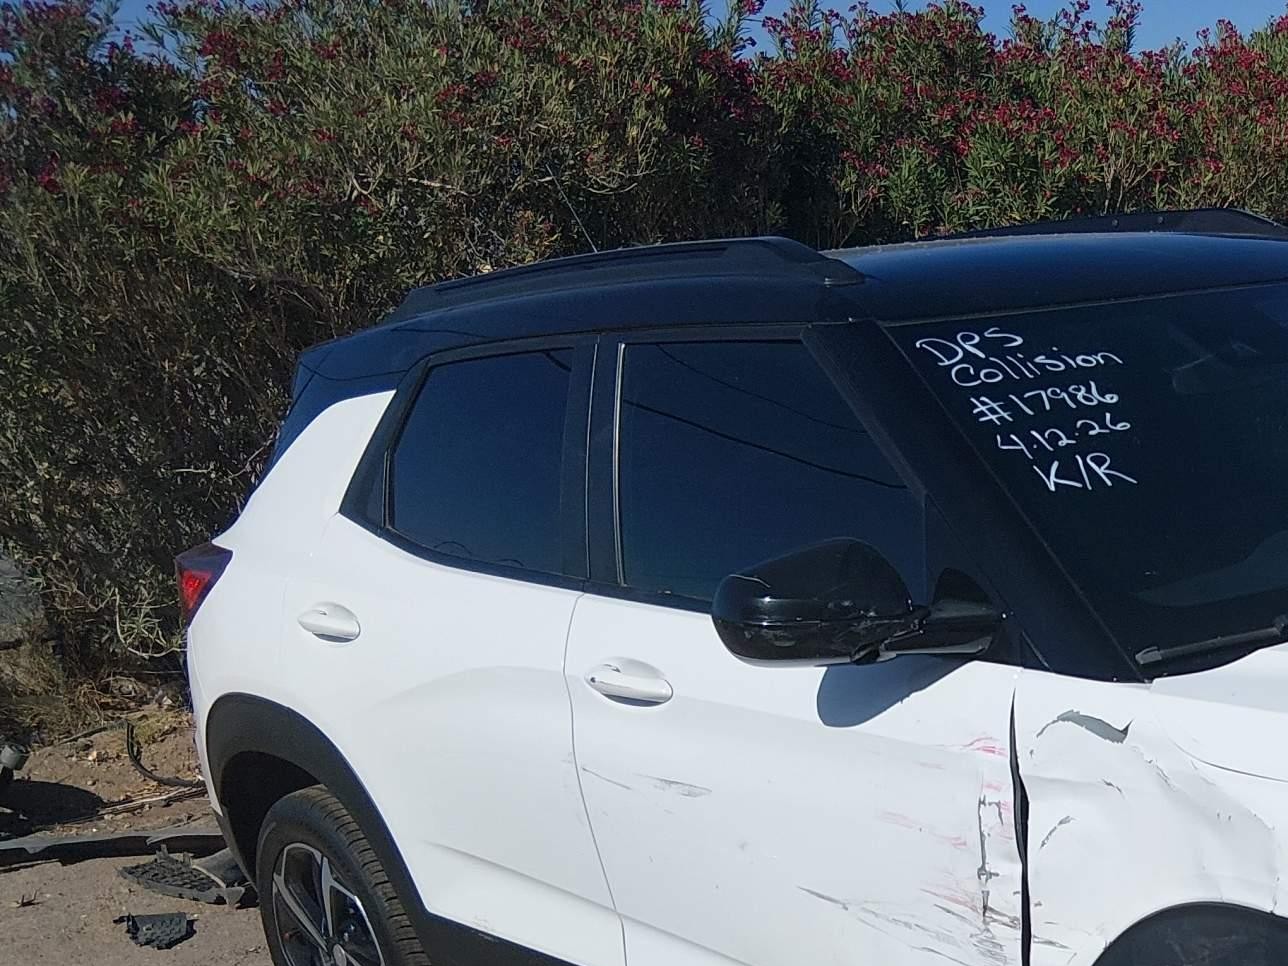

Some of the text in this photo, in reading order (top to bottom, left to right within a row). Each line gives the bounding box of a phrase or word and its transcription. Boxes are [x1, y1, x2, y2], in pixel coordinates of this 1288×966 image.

[915, 327, 1023, 366] DPS
[951, 347, 1124, 386] Collision
[970, 380, 1119, 425] #17986
[1033, 452, 1138, 491] K/R
